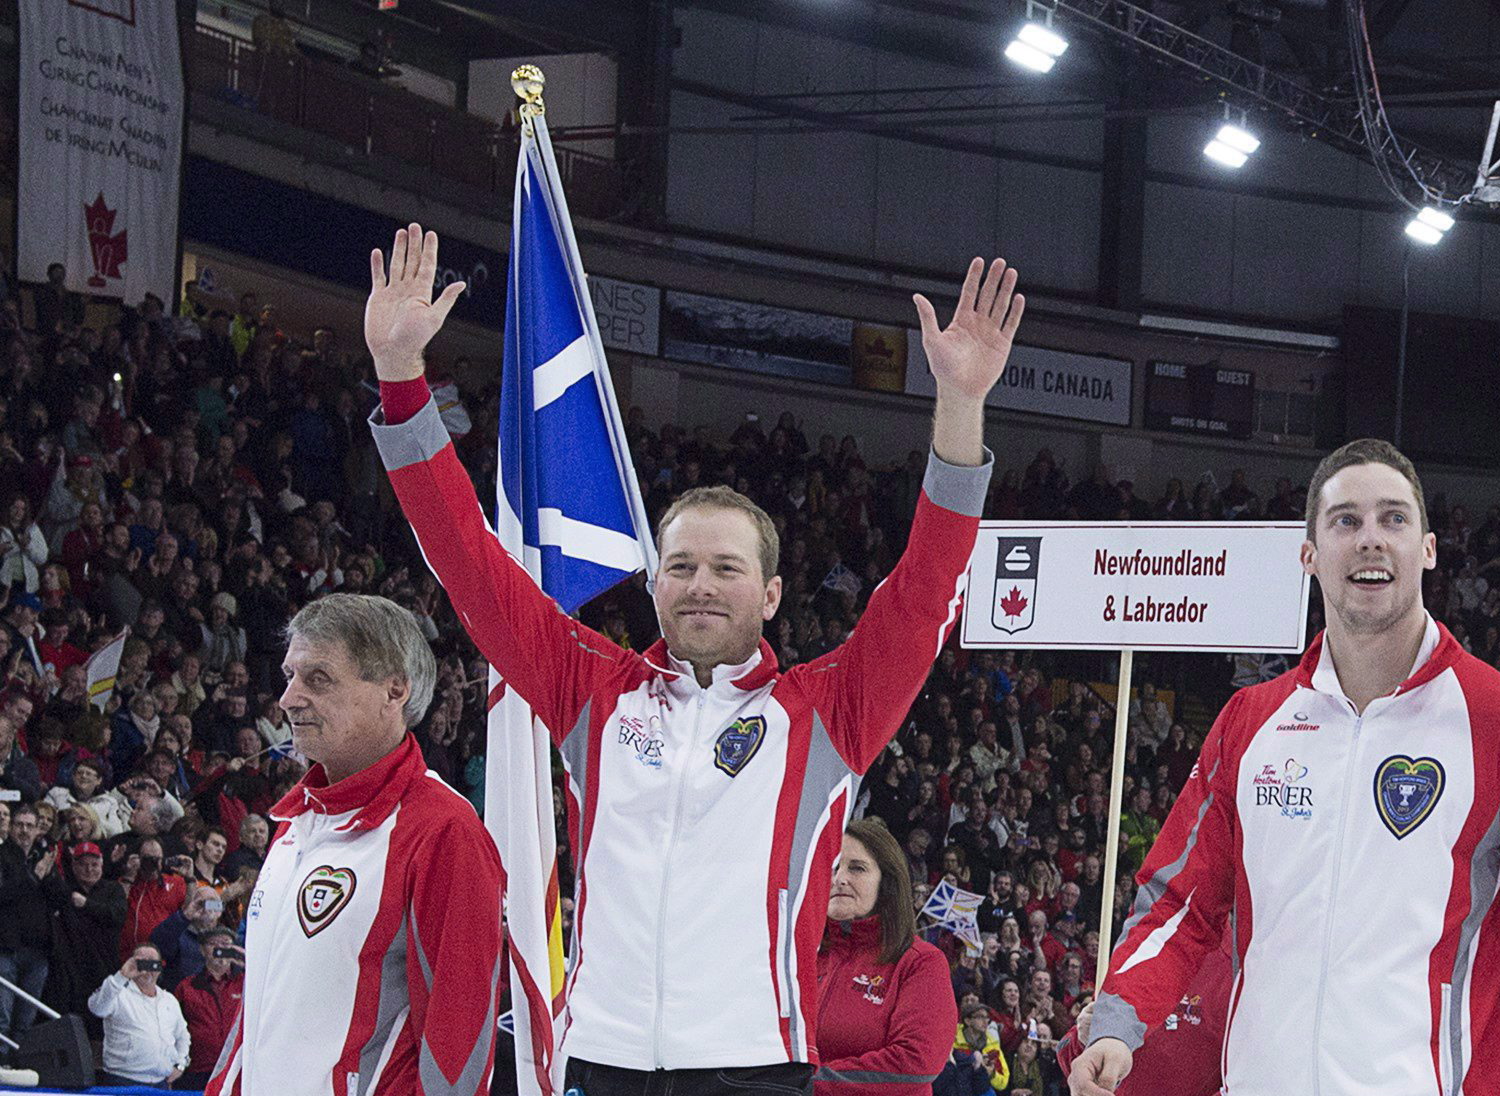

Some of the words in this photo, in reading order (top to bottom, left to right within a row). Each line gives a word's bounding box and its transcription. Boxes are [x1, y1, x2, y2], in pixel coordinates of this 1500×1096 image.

[1042, 369, 1114, 401] CANADA
[1154, 362, 1186, 379] HOME
[1216, 369, 1251, 386] GUEST
[1093, 548, 1227, 577] Newfoundland
[1103, 594, 1116, 622] &
[1123, 595, 1208, 623] Labrador
